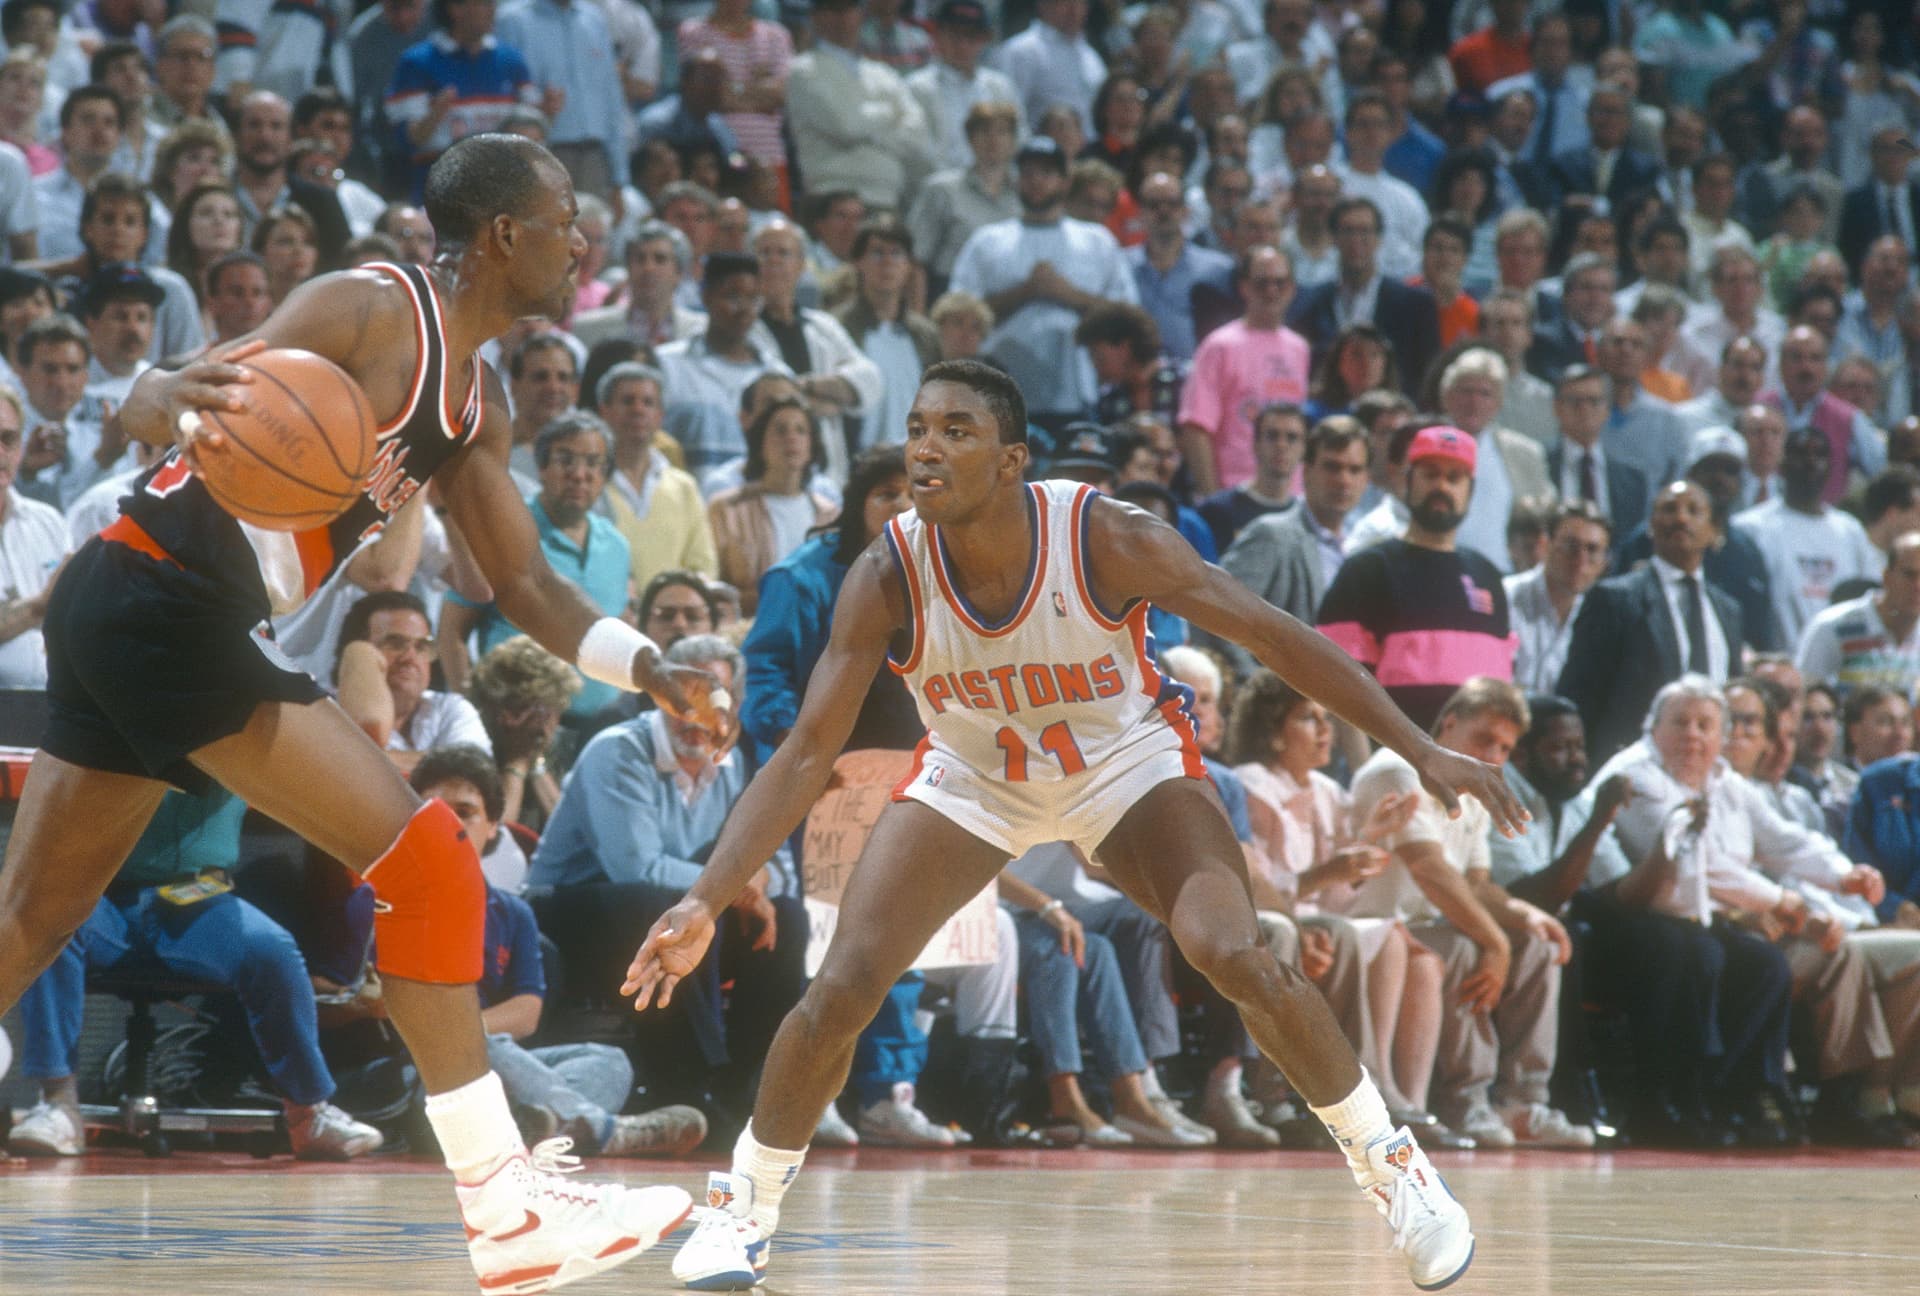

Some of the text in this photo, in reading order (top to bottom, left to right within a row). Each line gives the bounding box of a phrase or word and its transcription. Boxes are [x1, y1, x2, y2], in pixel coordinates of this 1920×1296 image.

[923, 653, 1125, 715] PISTONS
[996, 719, 1087, 782] 11
[804, 863, 843, 893] BUT
